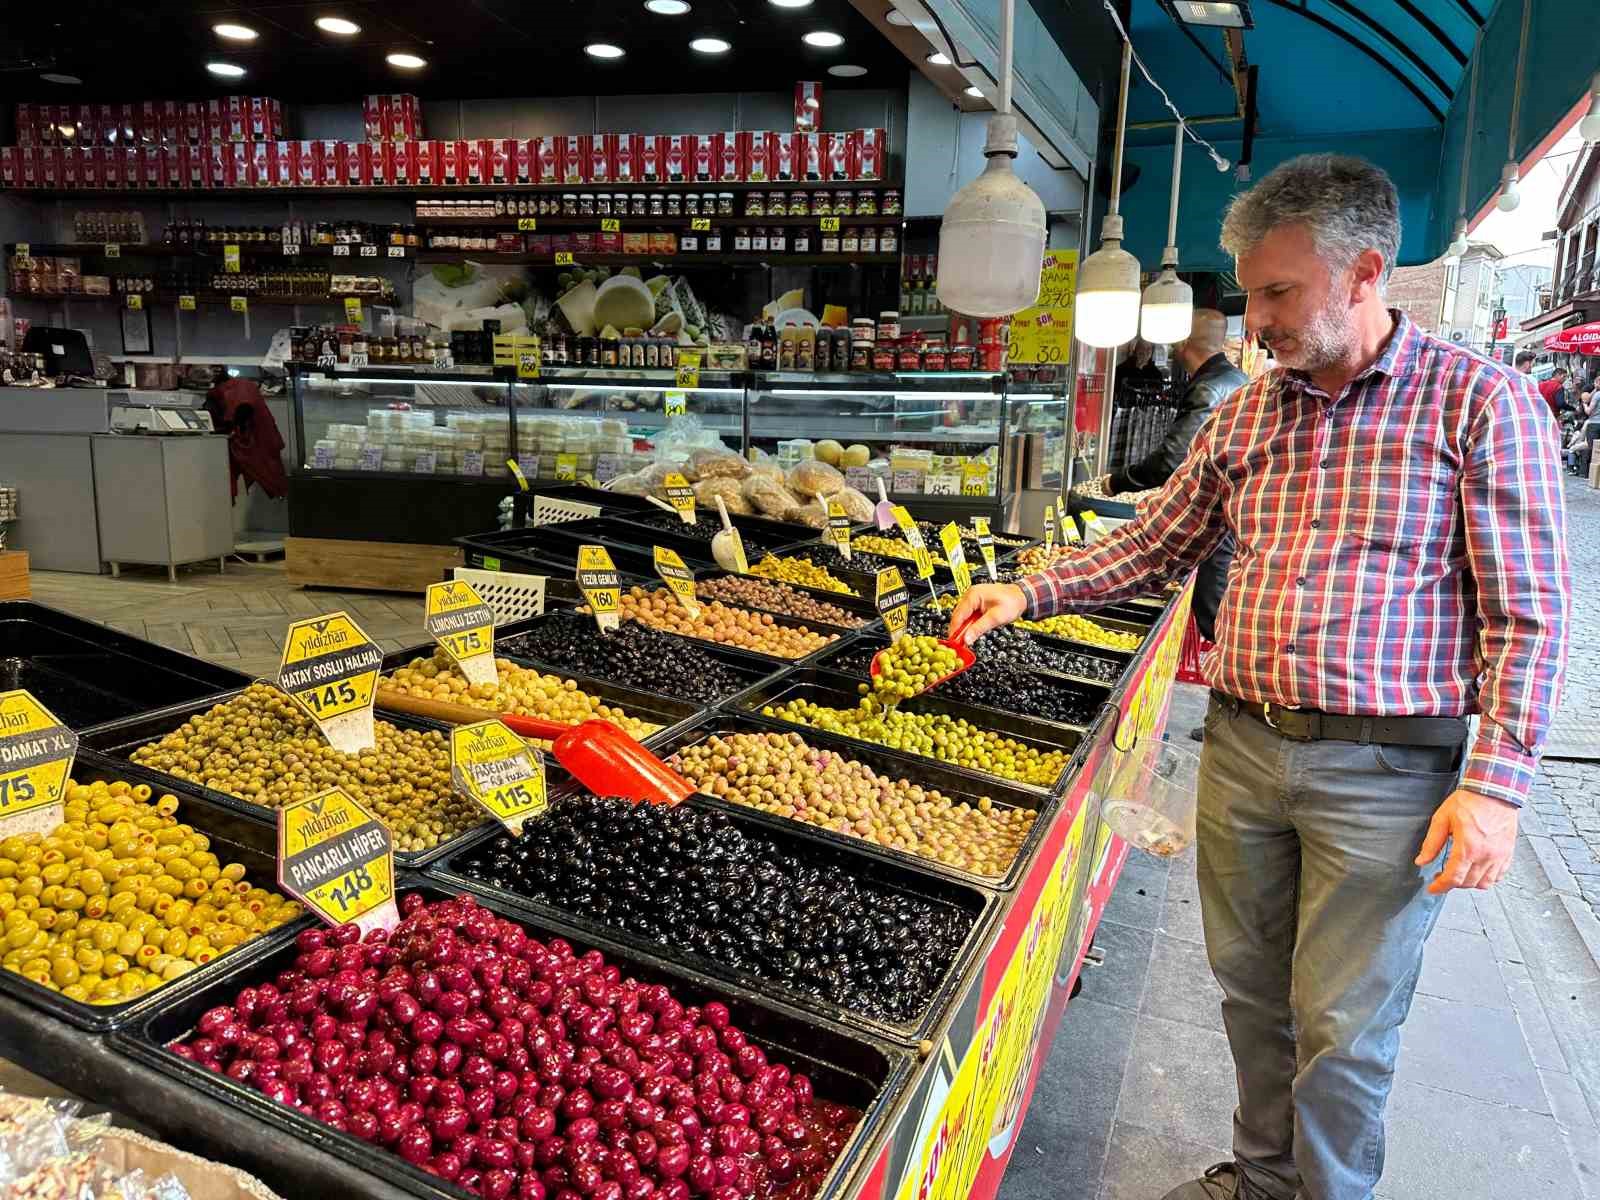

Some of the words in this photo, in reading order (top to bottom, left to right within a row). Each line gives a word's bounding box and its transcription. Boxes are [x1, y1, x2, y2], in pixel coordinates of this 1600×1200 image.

[1571, 332, 1600, 341] ALGID
[1037, 345, 1061, 363] 30
[593, 592, 612, 606] 160
[889, 609, 904, 626] 150
[448, 632, 480, 653] 175
[281, 668, 312, 689] HATAY
[313, 661, 344, 680] SOSLU
[345, 650, 381, 671] HALHAL
[310, 681, 356, 712] 145
[1, 738, 48, 763] DAMAT
[52, 734, 71, 751] XL
[495, 784, 532, 809] 115
[291, 843, 352, 886] PANCARLI
[349, 828, 386, 858] HİPER
